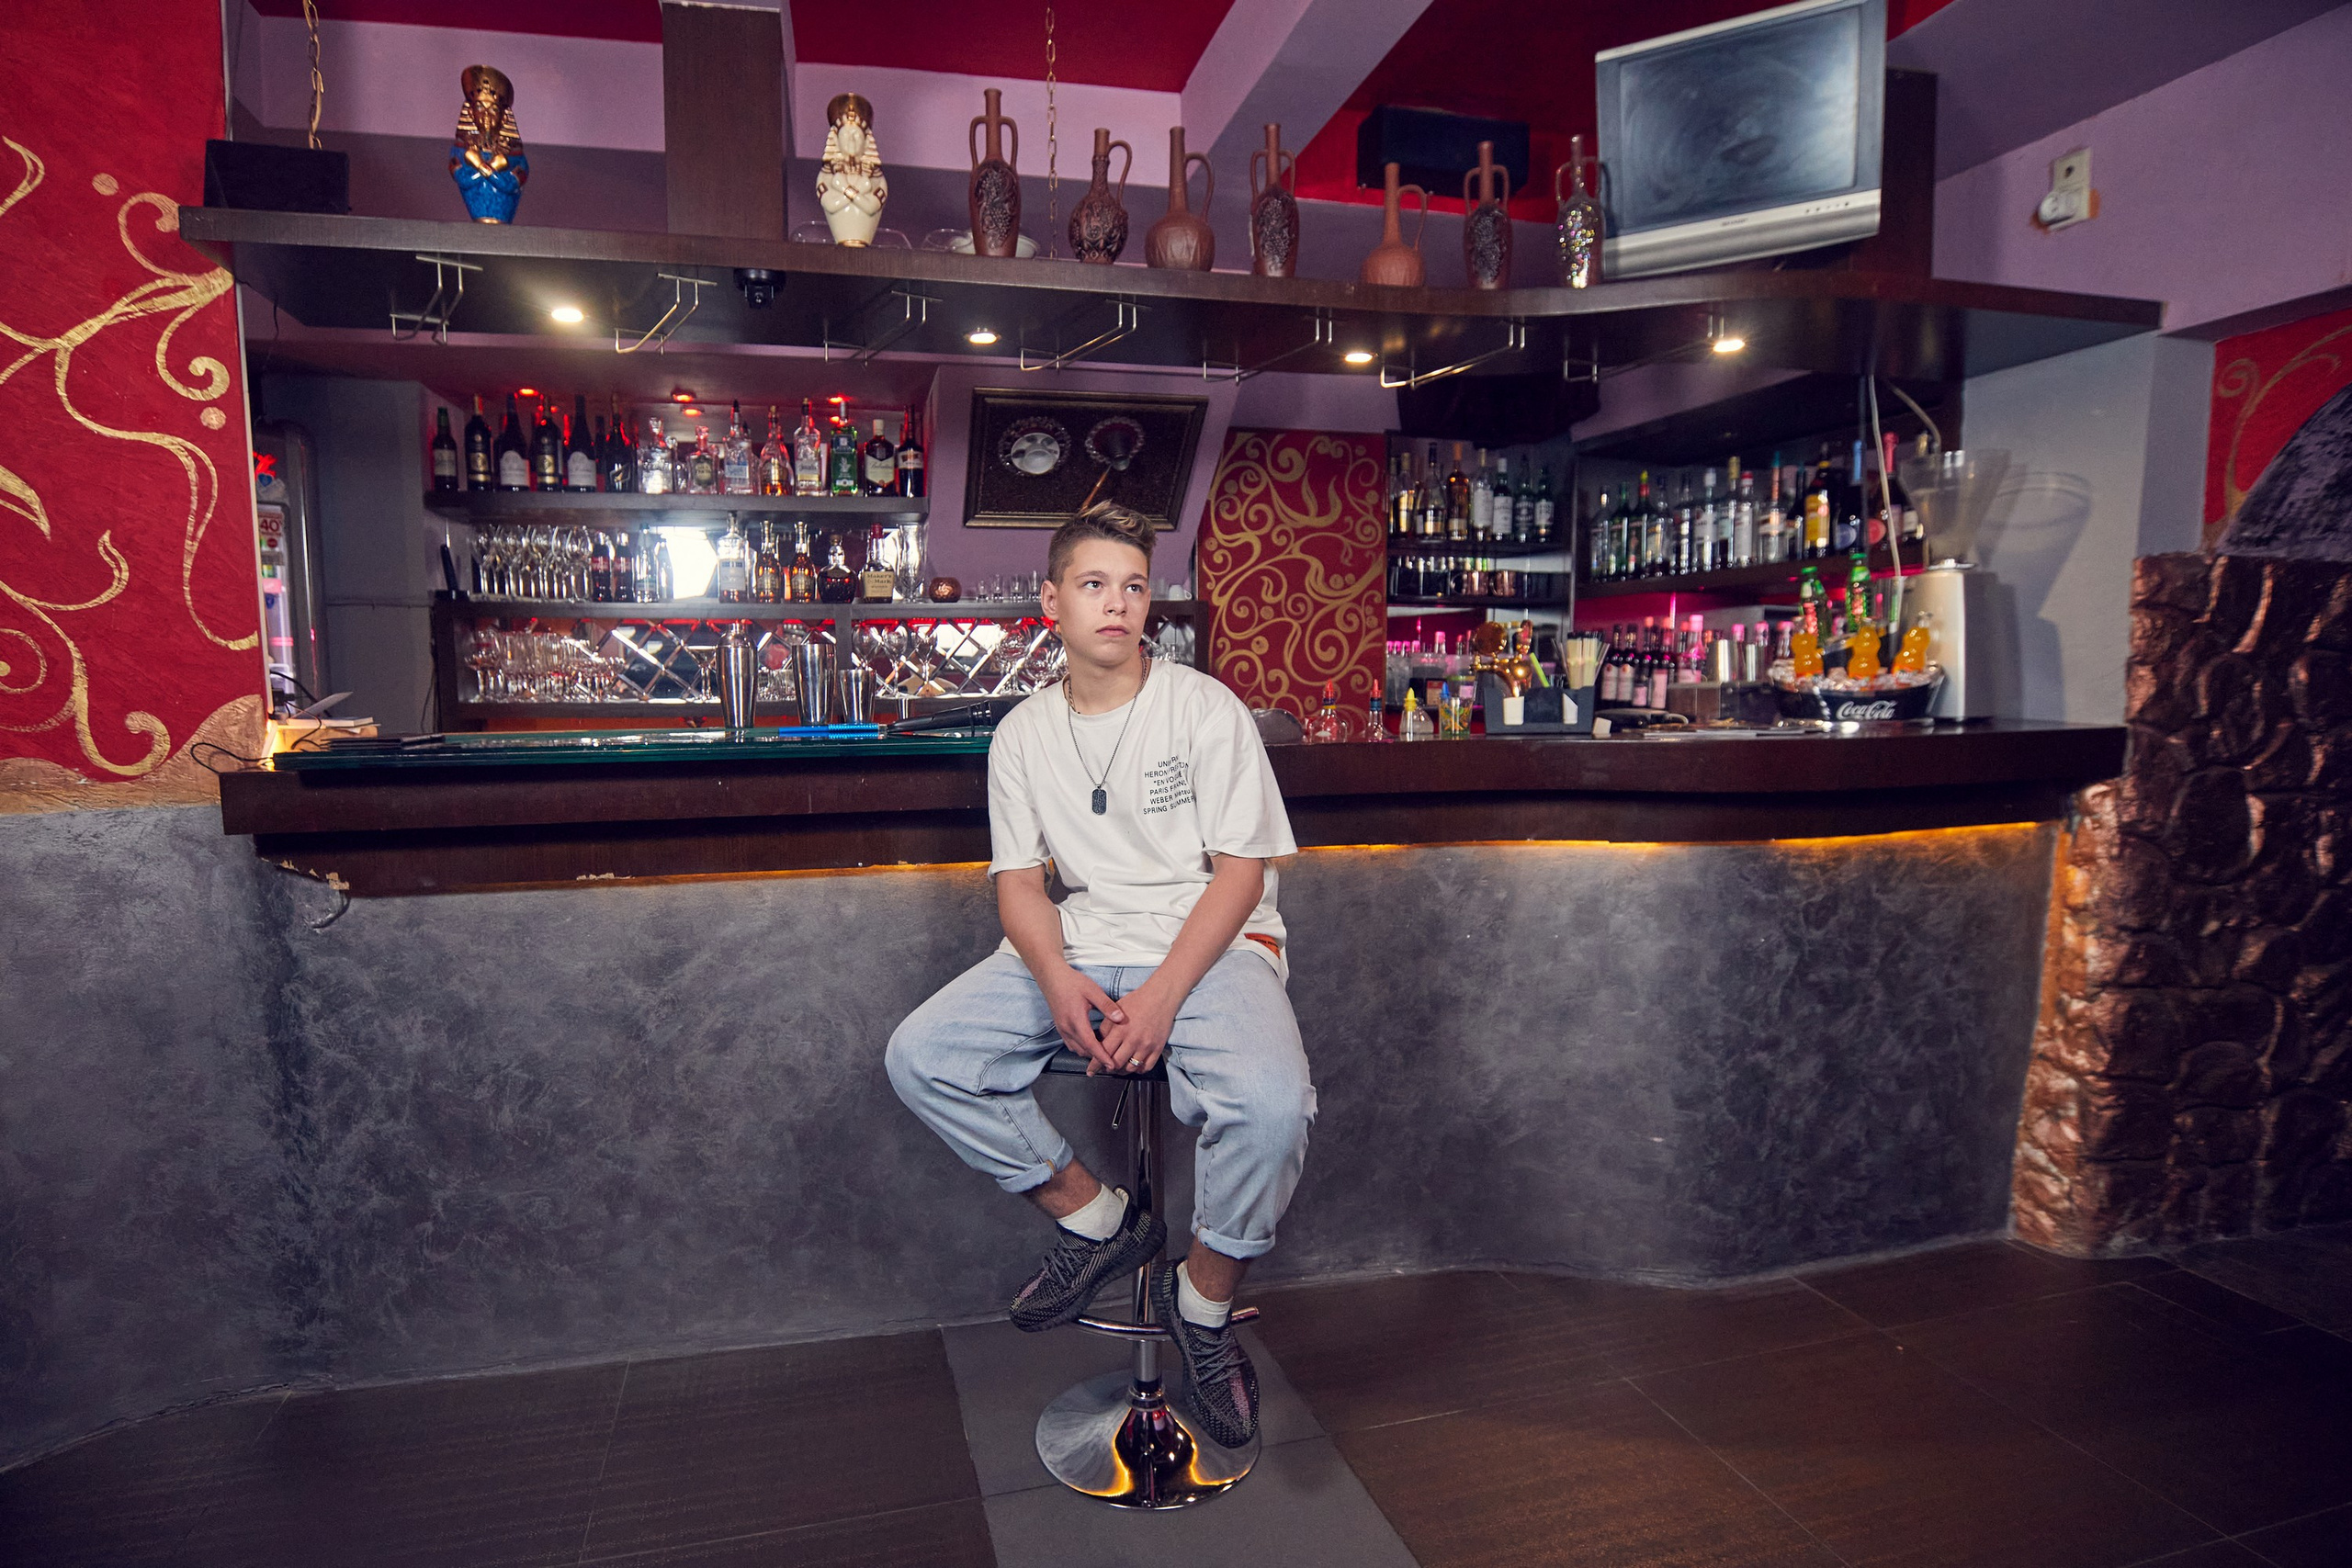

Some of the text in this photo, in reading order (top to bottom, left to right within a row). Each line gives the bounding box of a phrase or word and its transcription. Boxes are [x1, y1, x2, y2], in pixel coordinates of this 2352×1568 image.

[1149, 786, 1169, 795] PARIS
[1143, 795, 1195, 815] SPRING SUMMER
[1149, 795, 1173, 805] WEBER
